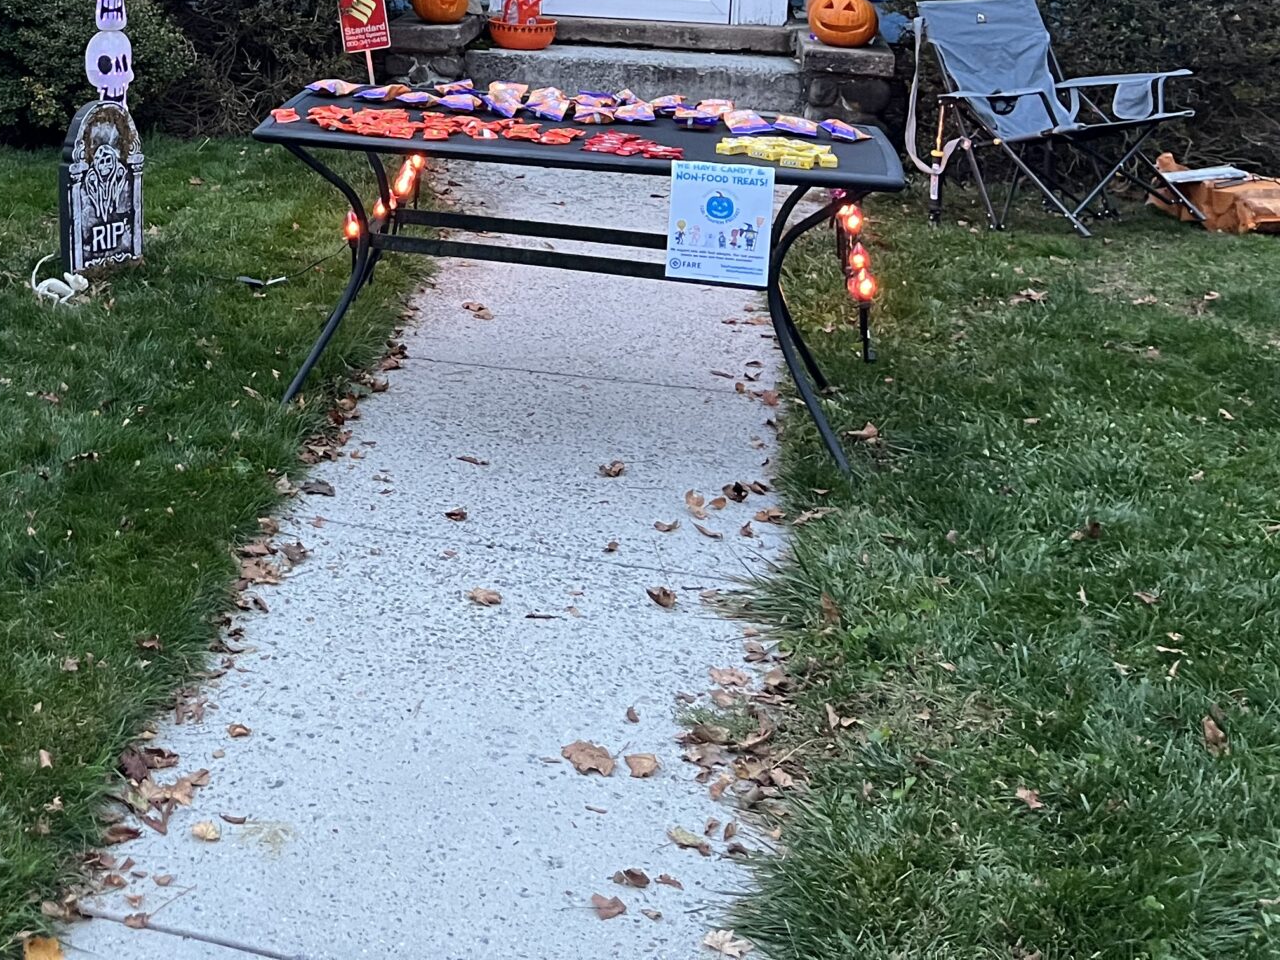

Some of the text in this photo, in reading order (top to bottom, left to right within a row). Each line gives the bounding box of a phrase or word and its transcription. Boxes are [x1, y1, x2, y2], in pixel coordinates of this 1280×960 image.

[344, 23, 385, 36] Standard
[693, 164, 717, 172] HAVE
[720, 166, 753, 175] CANDY
[676, 170, 769, 187] NON-FOOD TREATS!
[92, 221, 125, 252] RIP
[682, 260, 702, 269] FARE
